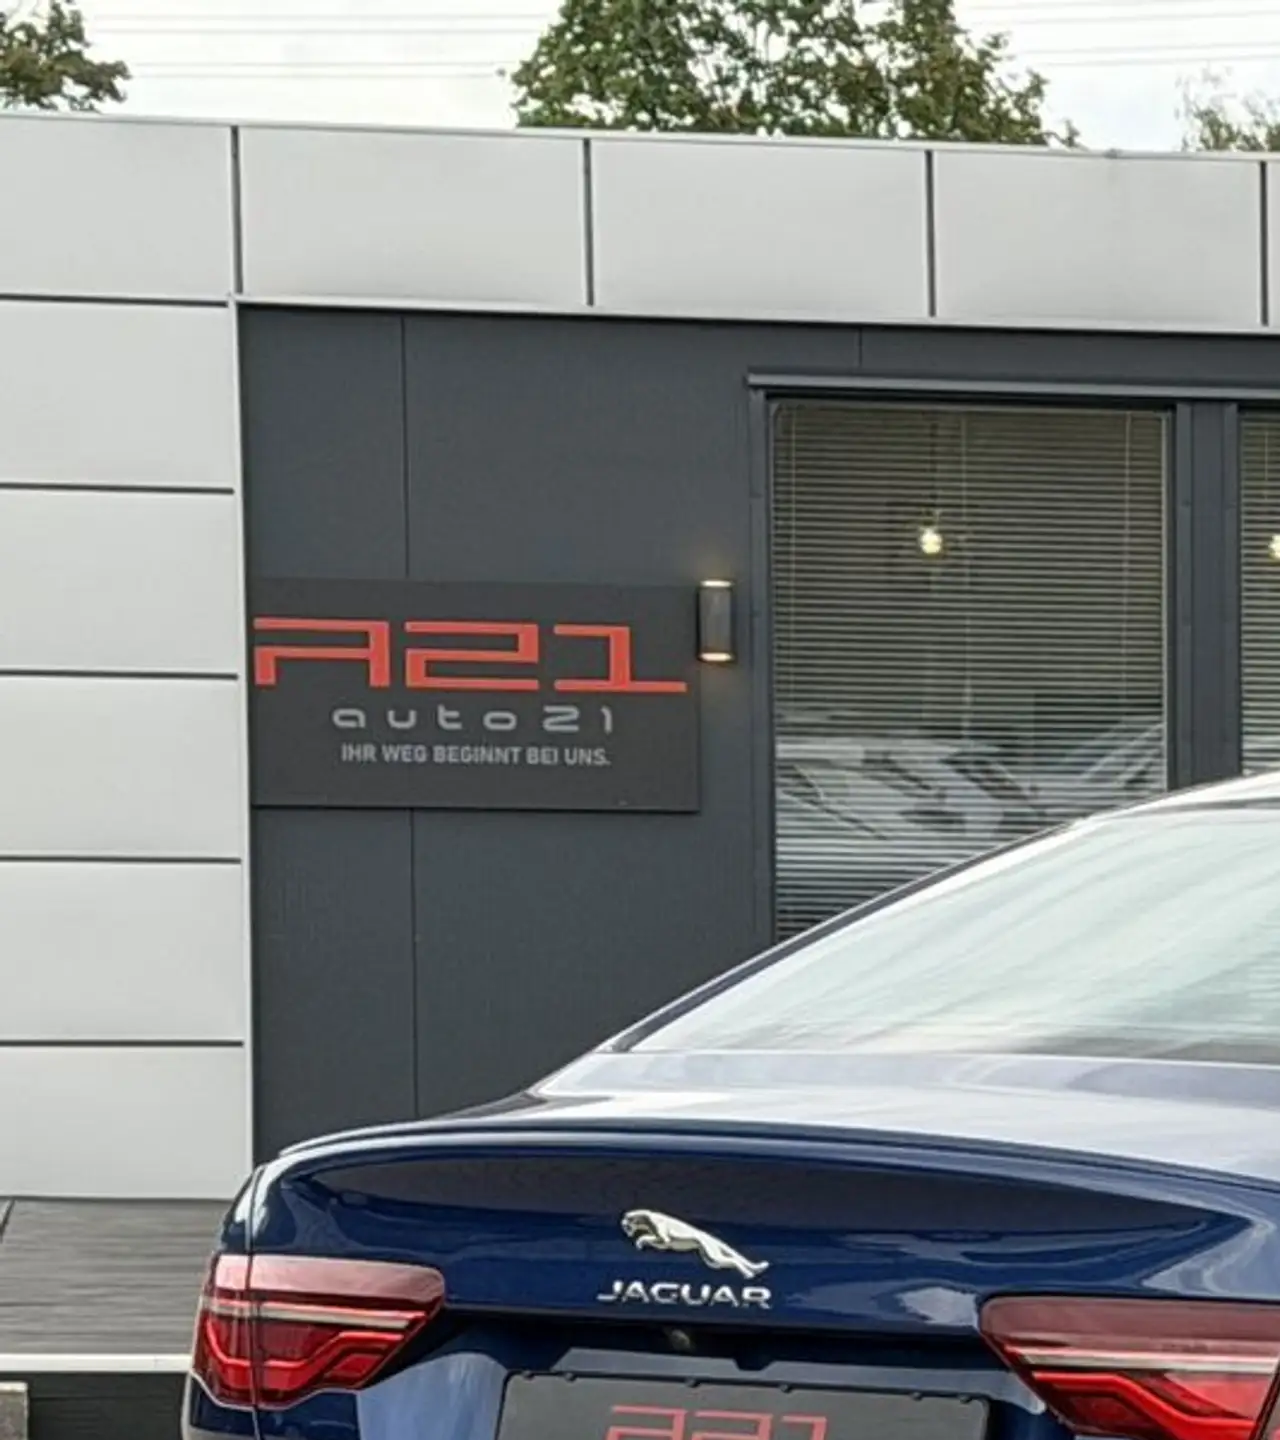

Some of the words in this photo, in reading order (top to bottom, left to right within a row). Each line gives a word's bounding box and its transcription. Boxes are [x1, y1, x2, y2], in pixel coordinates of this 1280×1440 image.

[253, 617, 687, 693] A21
[341, 743, 377, 763] IHR
[382, 743, 427, 763] WEG
[433, 744, 522, 765] BEGINNT
[527, 747, 559, 766] BEI
[564, 748, 611, 767] UNS.
[597, 1278, 771, 1310] JAGUAR
